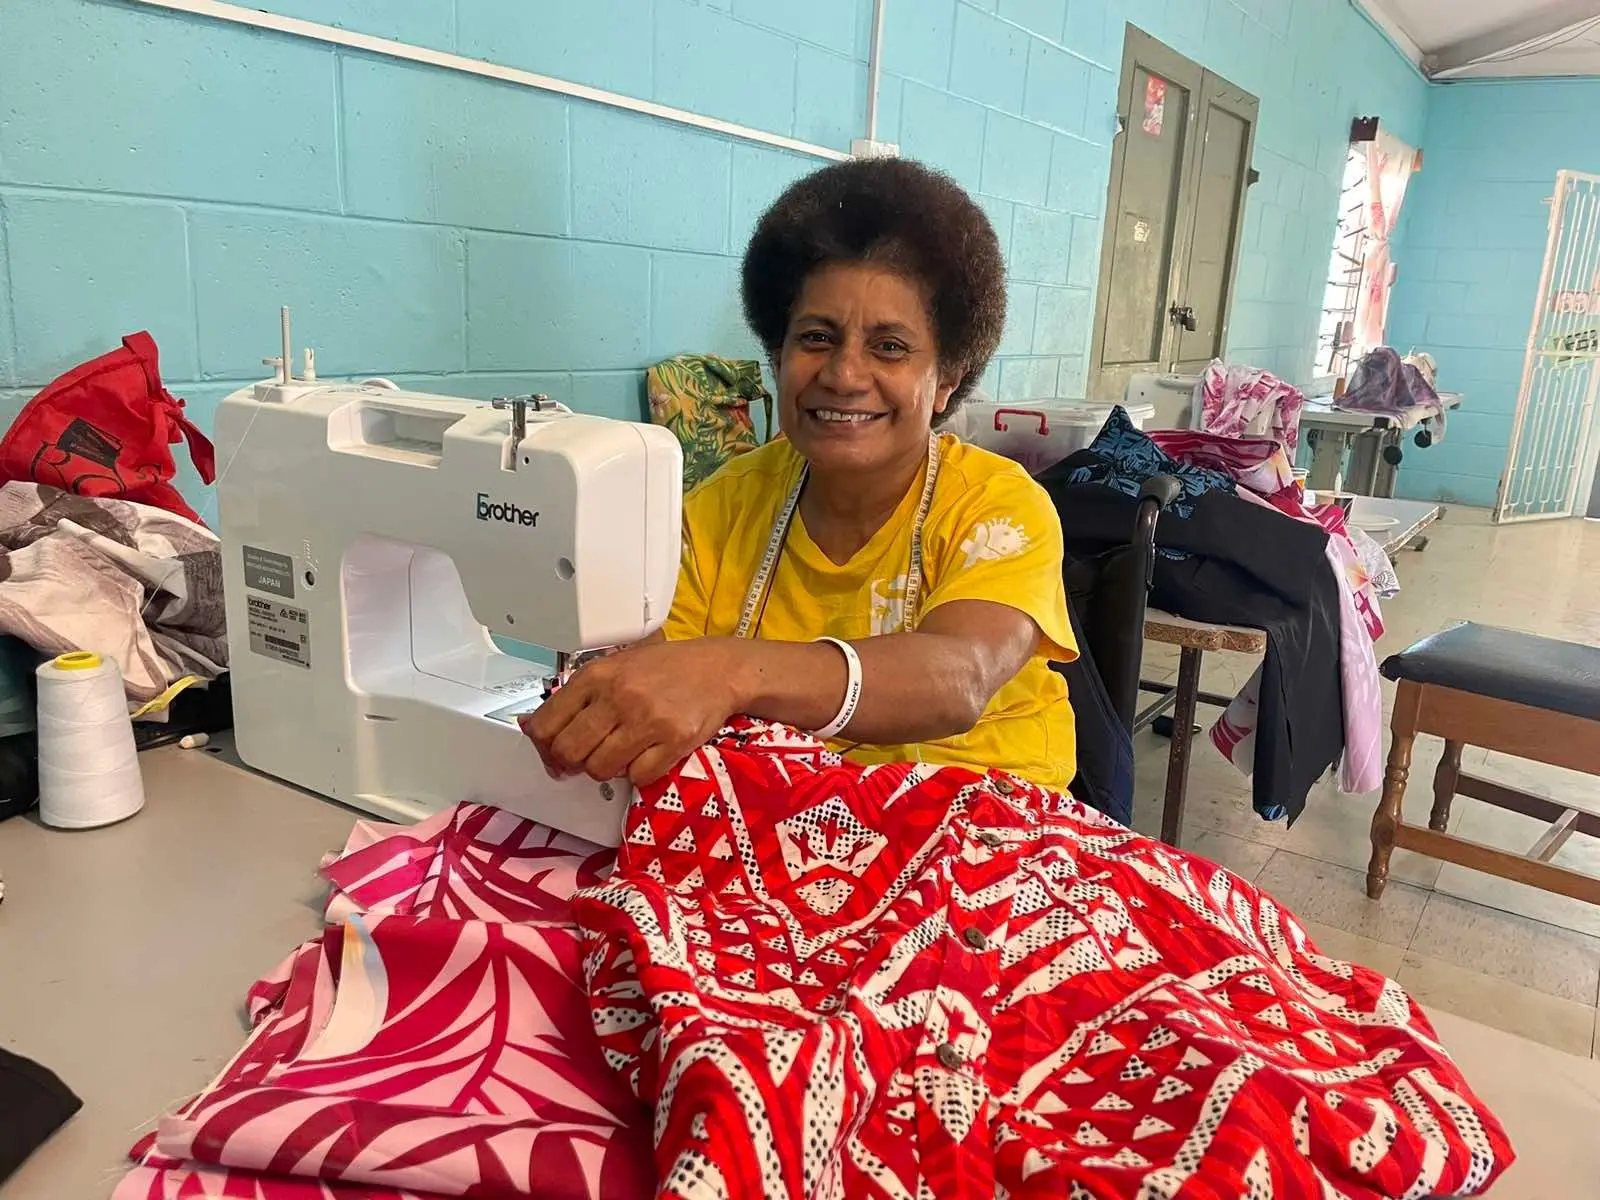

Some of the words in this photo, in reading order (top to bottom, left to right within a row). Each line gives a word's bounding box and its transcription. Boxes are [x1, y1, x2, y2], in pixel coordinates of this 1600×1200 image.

[477, 493, 539, 527] brother
[257, 575, 281, 589] JAPAN
[836, 681, 859, 728] EXCELLENCE
